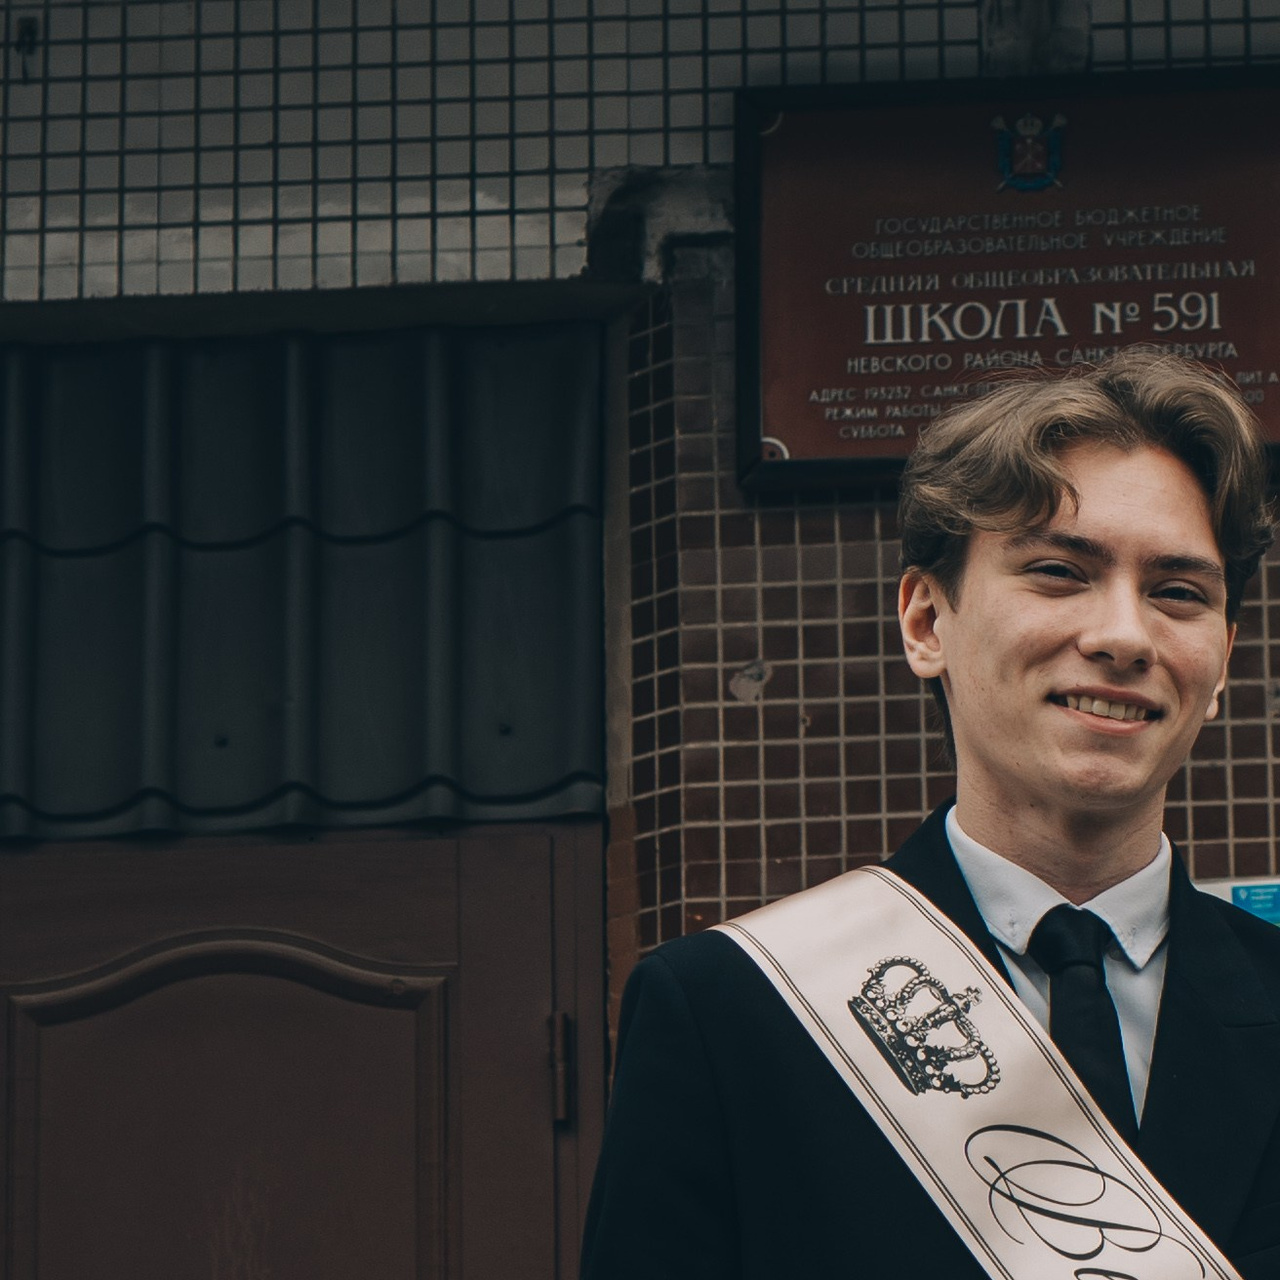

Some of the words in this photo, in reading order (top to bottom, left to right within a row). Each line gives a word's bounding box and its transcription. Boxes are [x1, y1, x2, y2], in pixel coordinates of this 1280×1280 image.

[875, 210, 1062, 235] ГОСУДАРСТВЕННОЕ
[1075, 205, 1201, 226] БЮДЖЕТНОЕ
[852, 232, 1087, 259] ОБЩЕОБРАЗОВАТЕЛЬНОЕ
[1103, 227, 1227, 247] УЧРЕЖДЕНИЕ
[825, 273, 940, 295] СРЕДНЯЯ
[952, 260, 1256, 289] ОБЩЕОБРАЗОВАТЕЛЬНАЯ
[864, 297, 1069, 345] ШКОЛА
[1153, 291, 1222, 332] 591
[847, 353, 952, 374] НЕВСКОГО
